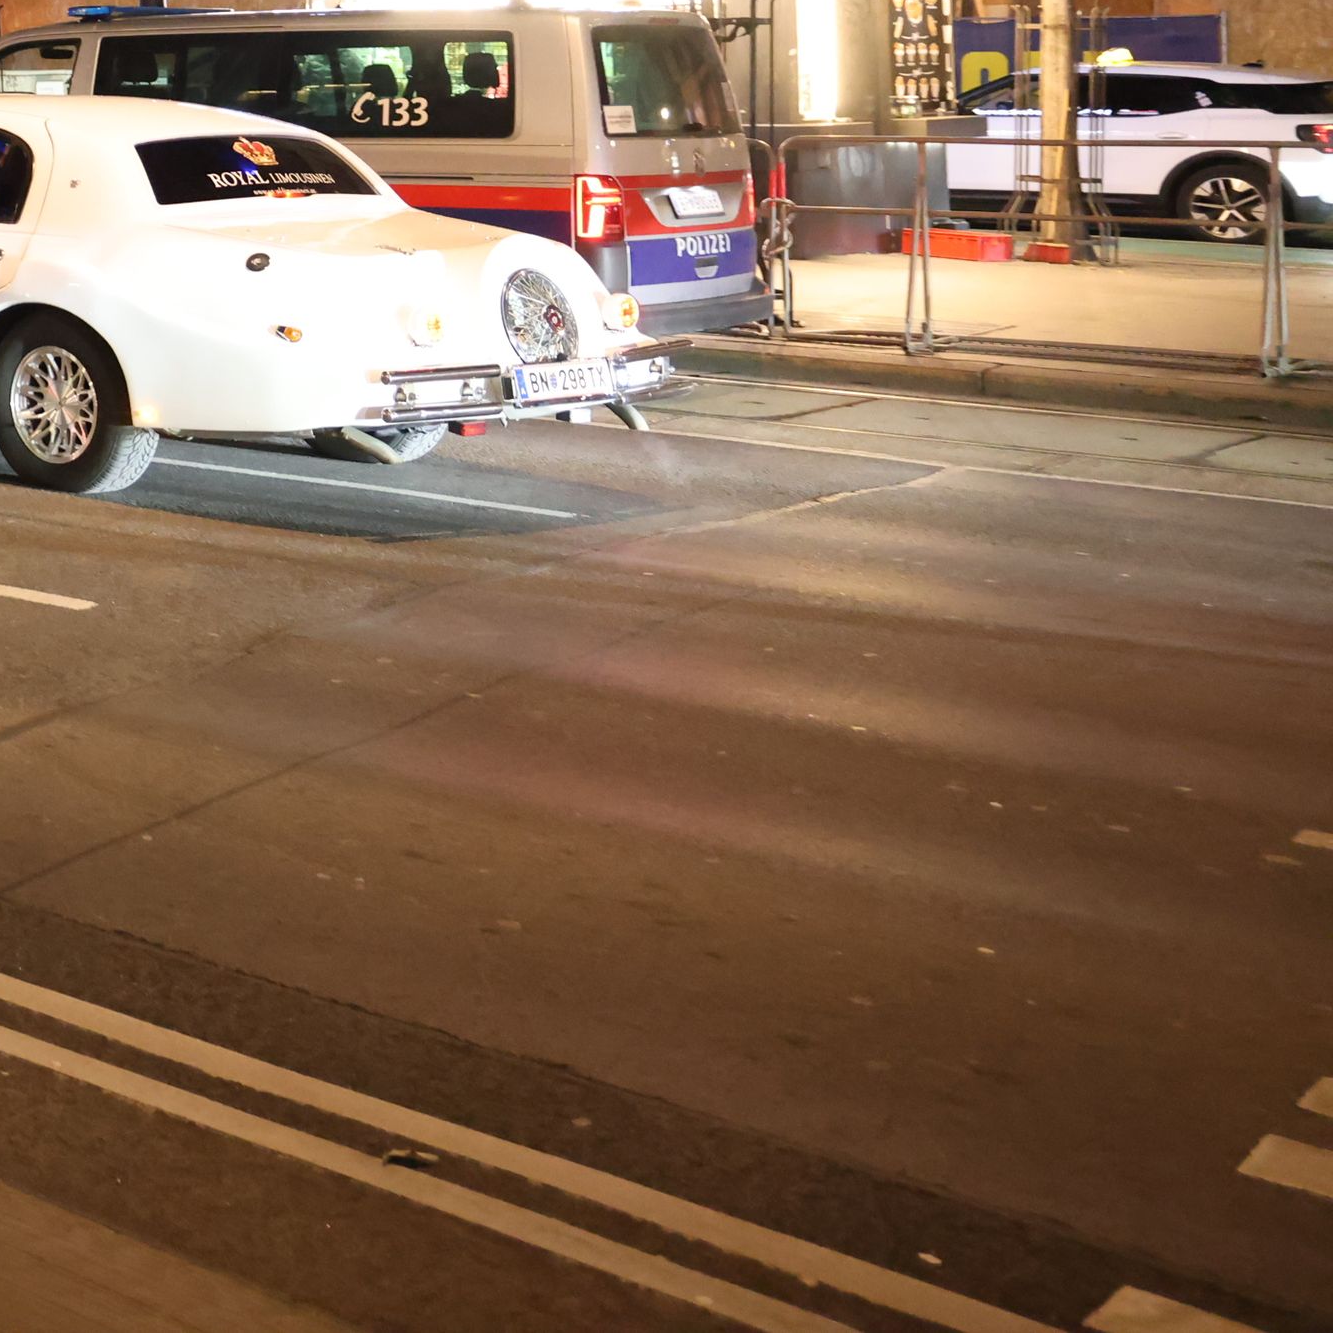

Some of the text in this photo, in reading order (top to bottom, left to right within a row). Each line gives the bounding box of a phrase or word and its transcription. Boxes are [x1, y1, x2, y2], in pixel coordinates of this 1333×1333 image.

[377, 97, 428, 126] 133
[207, 170, 335, 188] ROYAL LIMOUSINEN
[675, 233, 731, 257] POLIZEI
[529, 367, 604, 393] BN 298 TX
